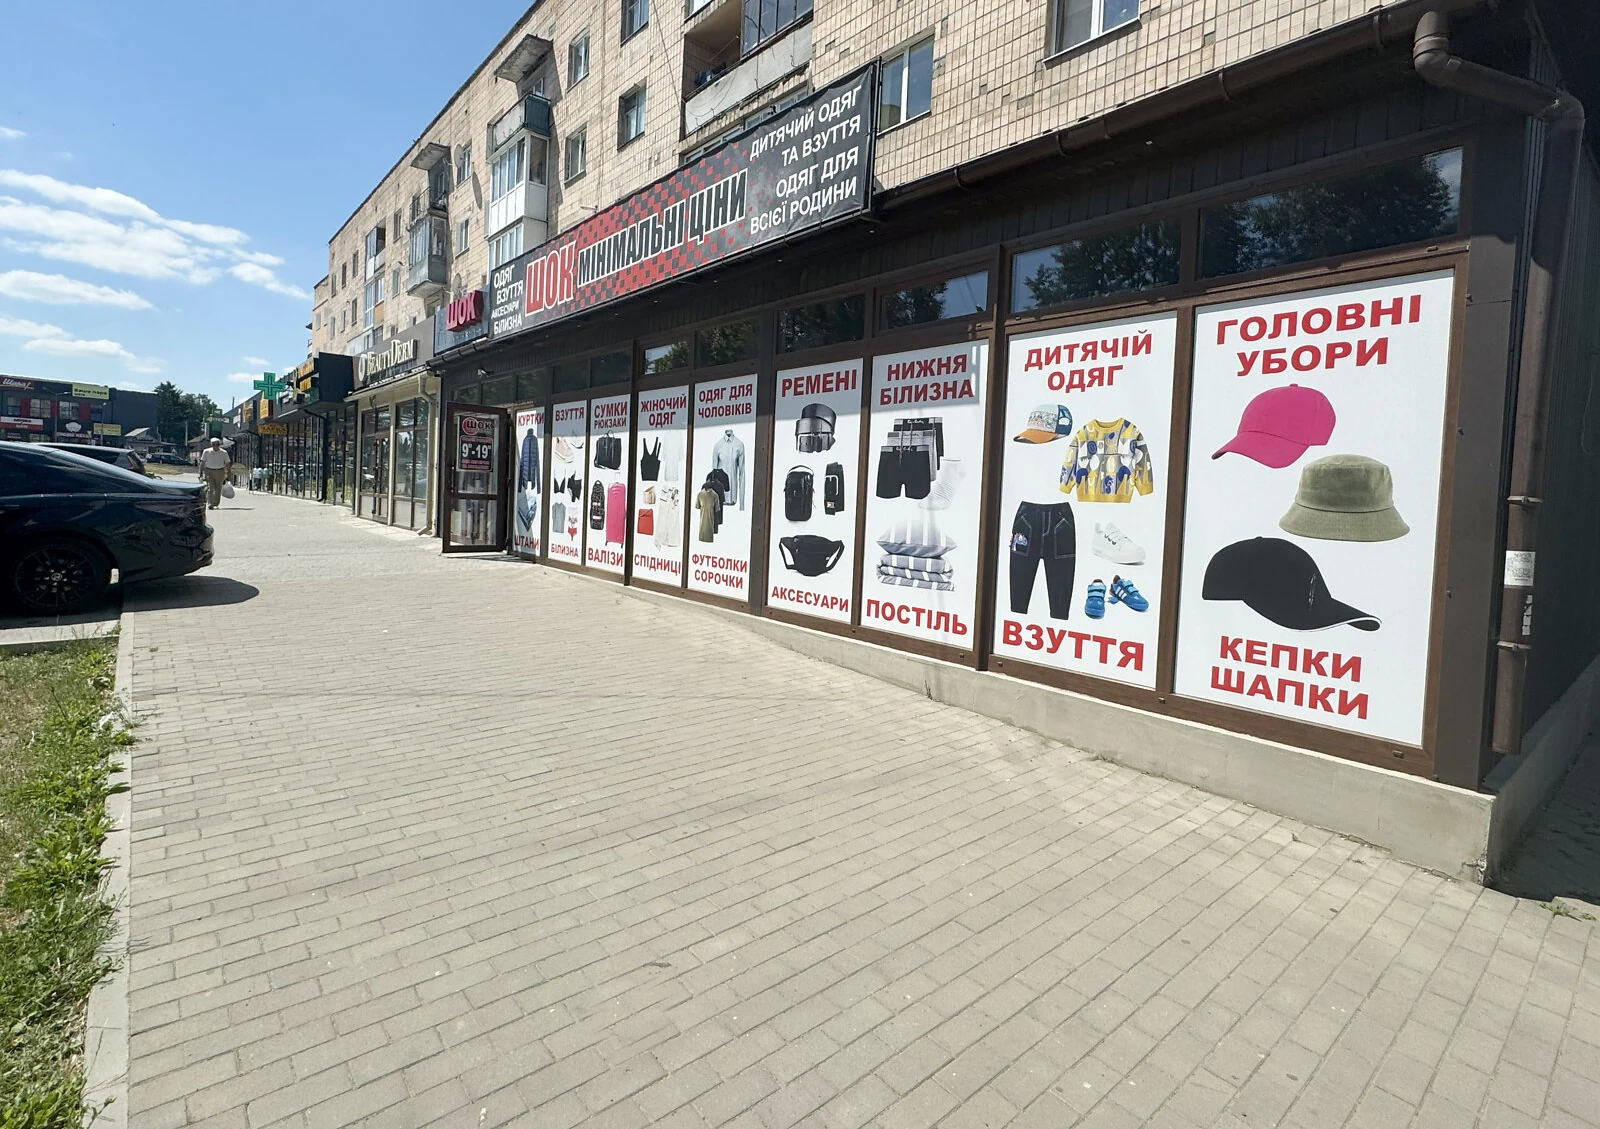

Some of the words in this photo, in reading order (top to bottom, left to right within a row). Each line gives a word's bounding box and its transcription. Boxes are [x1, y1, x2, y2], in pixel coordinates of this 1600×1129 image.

[750, 108, 815, 162] ДИТЯЧИЙ
[818, 85, 863, 123] ОДЯГ
[781, 146, 799, 165] ТА
[802, 114, 862, 156] ВЗУТТЯ
[775, 167, 819, 198] ОДЯГ
[821, 146, 859, 182] ДЛЯ
[750, 203, 786, 235] ВСІЄЇ
[789, 177, 857, 220] РОДИНИ
[525, 240, 577, 317] ШОК
[577, 197, 687, 288] МІНІМАЛЬНІ
[687, 168, 748, 244] ЦІНИ
[494, 264, 515, 288] ОДЯГ
[496, 280, 524, 305] ВЗУТТЯ
[446, 291, 477, 330] ШОК
[493, 313, 523, 335] БІЛИЗНА
[1217, 294, 1422, 345] ГОЛОВНІ
[1024, 329, 1152, 371] ДИТЯЧІЙ
[1236, 337, 1389, 377] УБОРИ
[887, 354, 967, 382] НИЖНЯ
[1047, 365, 1124, 393] ОДЯГ
[698, 387, 727, 404] ОДЯГ
[728, 383, 753, 401] ДЛЯ
[781, 369, 857, 397] РЕМЕНІ
[880, 379, 974, 406] БІЛИЗНА
[555, 407, 584, 422] ВЗУТТЯ
[594, 401, 628, 418] СУМКИ
[640, 394, 687, 413] ЖІНОЧИЙ
[698, 402, 752, 419] ЧОЛОВІКІВ
[517, 412, 545, 427] КУРТКИ
[593, 417, 627, 429] РЮКЗАКИ
[648, 411, 676, 428] ОДЯГ
[514, 535, 540, 549] ШТАНИ
[550, 543, 579, 558] БІЛИЗНА
[588, 548, 623, 567] ВАЛІЗИ
[634, 554, 681, 575] СПІДНИЦІ
[692, 553, 748, 573] ФУТБОЛКИ
[694, 569, 744, 589] СОРОЧКИ
[771, 586, 849, 613] АКСЕСУАРИ
[866, 599, 968, 636] ПОСТІЛЬ
[1002, 620, 1145, 672] ВЗУТТЯ
[1220, 635, 1362, 683] КЕПКИ
[1210, 666, 1369, 720] ШАПКИ
